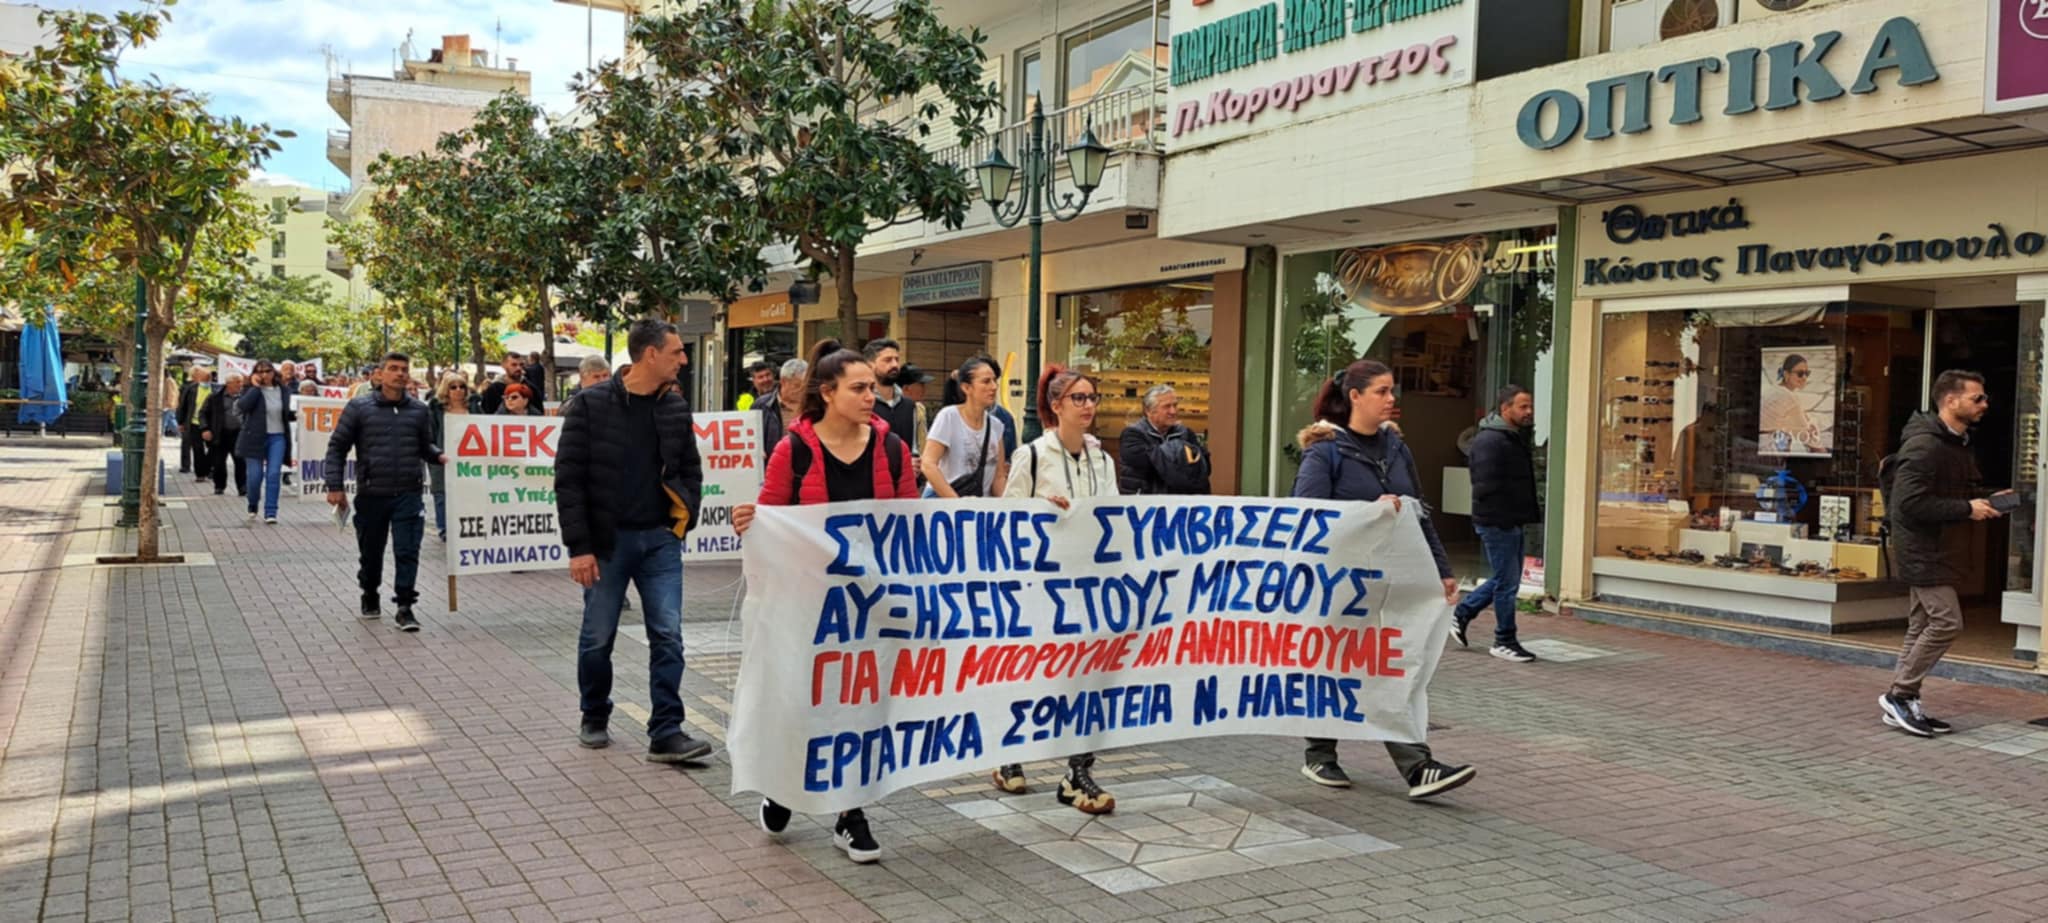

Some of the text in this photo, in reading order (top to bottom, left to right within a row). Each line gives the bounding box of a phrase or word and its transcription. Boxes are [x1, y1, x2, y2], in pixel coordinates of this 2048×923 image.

[1516, 15, 1941, 151] ΟΠΤΙΚΑ
[1583, 256, 1724, 287] Κώστας
[456, 461, 483, 478] Να
[487, 464, 520, 480] μας
[707, 453, 754, 470] ΤΩΡΑ
[488, 491, 510, 504] τα
[459, 544, 562, 567] ΣΥΝΔΙΚΑΤΟ
[824, 505, 1341, 577] ΣΥΛΛΟΓΙΚΕΣ ΣΥΜΒΑΣΕΙΣ
[814, 560, 1384, 645] ΑΥΞΗΣΕΙΣ ΣΤΟΥΣ ΜΙΣΘΟΥΣ
[812, 617, 1406, 707] ΓΙΑ ΝΑ ΜΠΟΡΟΥΜΕ ΝΑ ΑΝΑΠΝΕΟΥΜΕ
[804, 674, 1366, 793] ΕΡΓΑΤΙΚΑ ΣΩΜΑΤΕΙΑ Ν. ΗΛΕΙΑΣ
